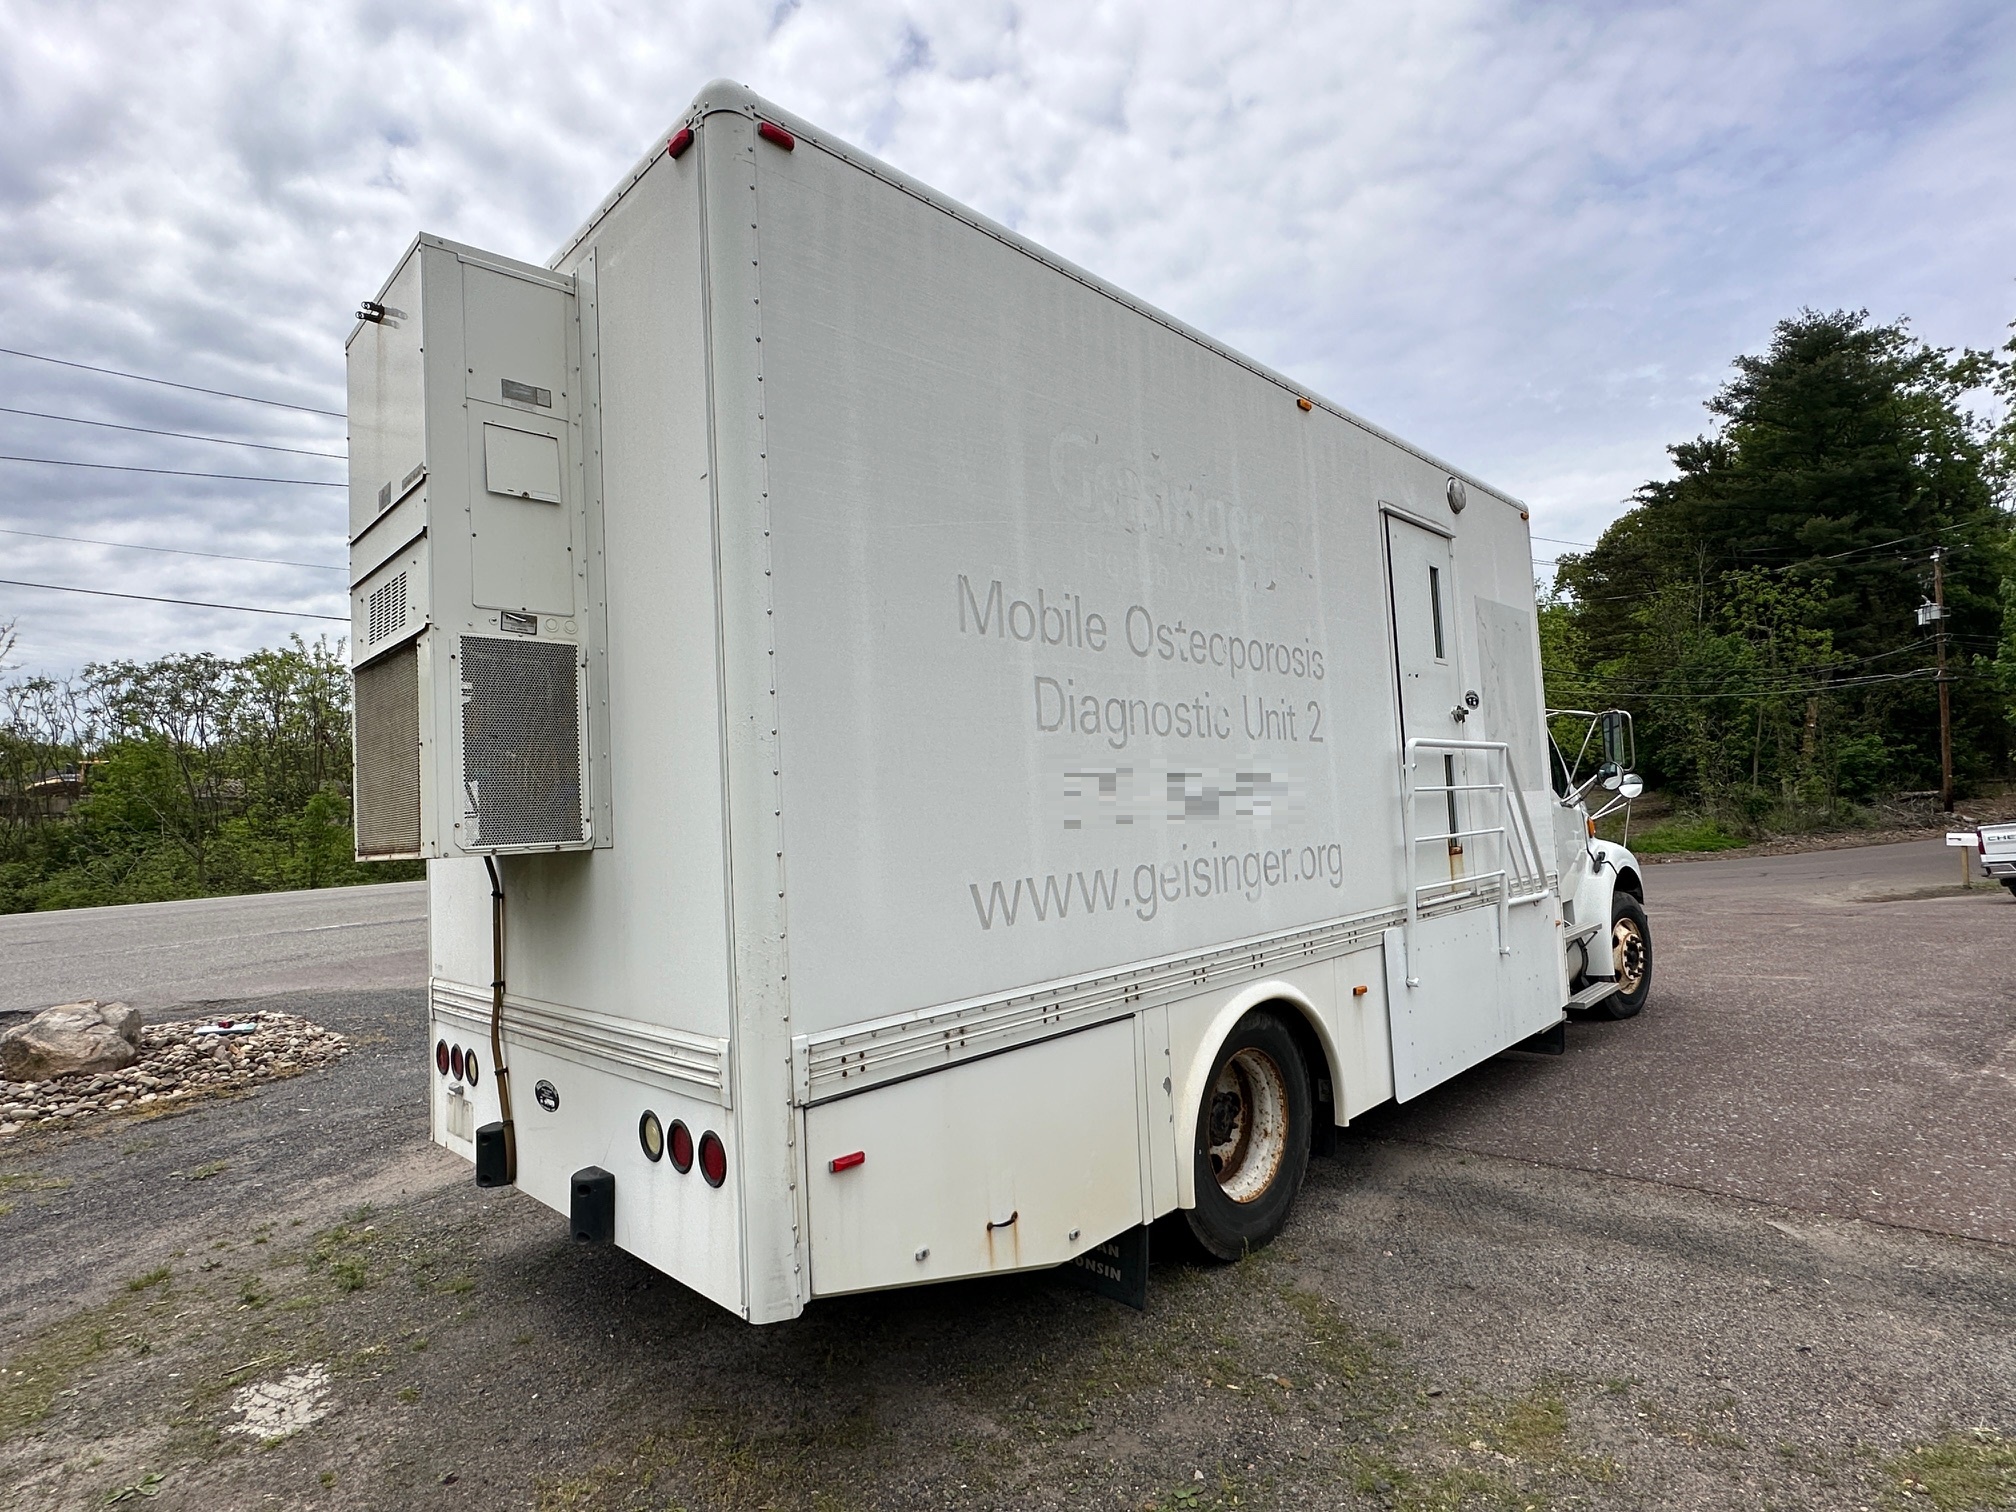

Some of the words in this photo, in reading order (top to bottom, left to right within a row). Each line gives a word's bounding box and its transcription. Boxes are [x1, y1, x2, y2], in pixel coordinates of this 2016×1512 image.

[957, 573, 1107, 652] Mobile
[1034, 675, 1230, 750] Diagnostic
[1242, 694, 1298, 742] Unit
[1306, 700, 1324, 743] 2
[969, 841, 1343, 931] www.geisinger.org
[1069, 1256, 1122, 1282] ONSIN
